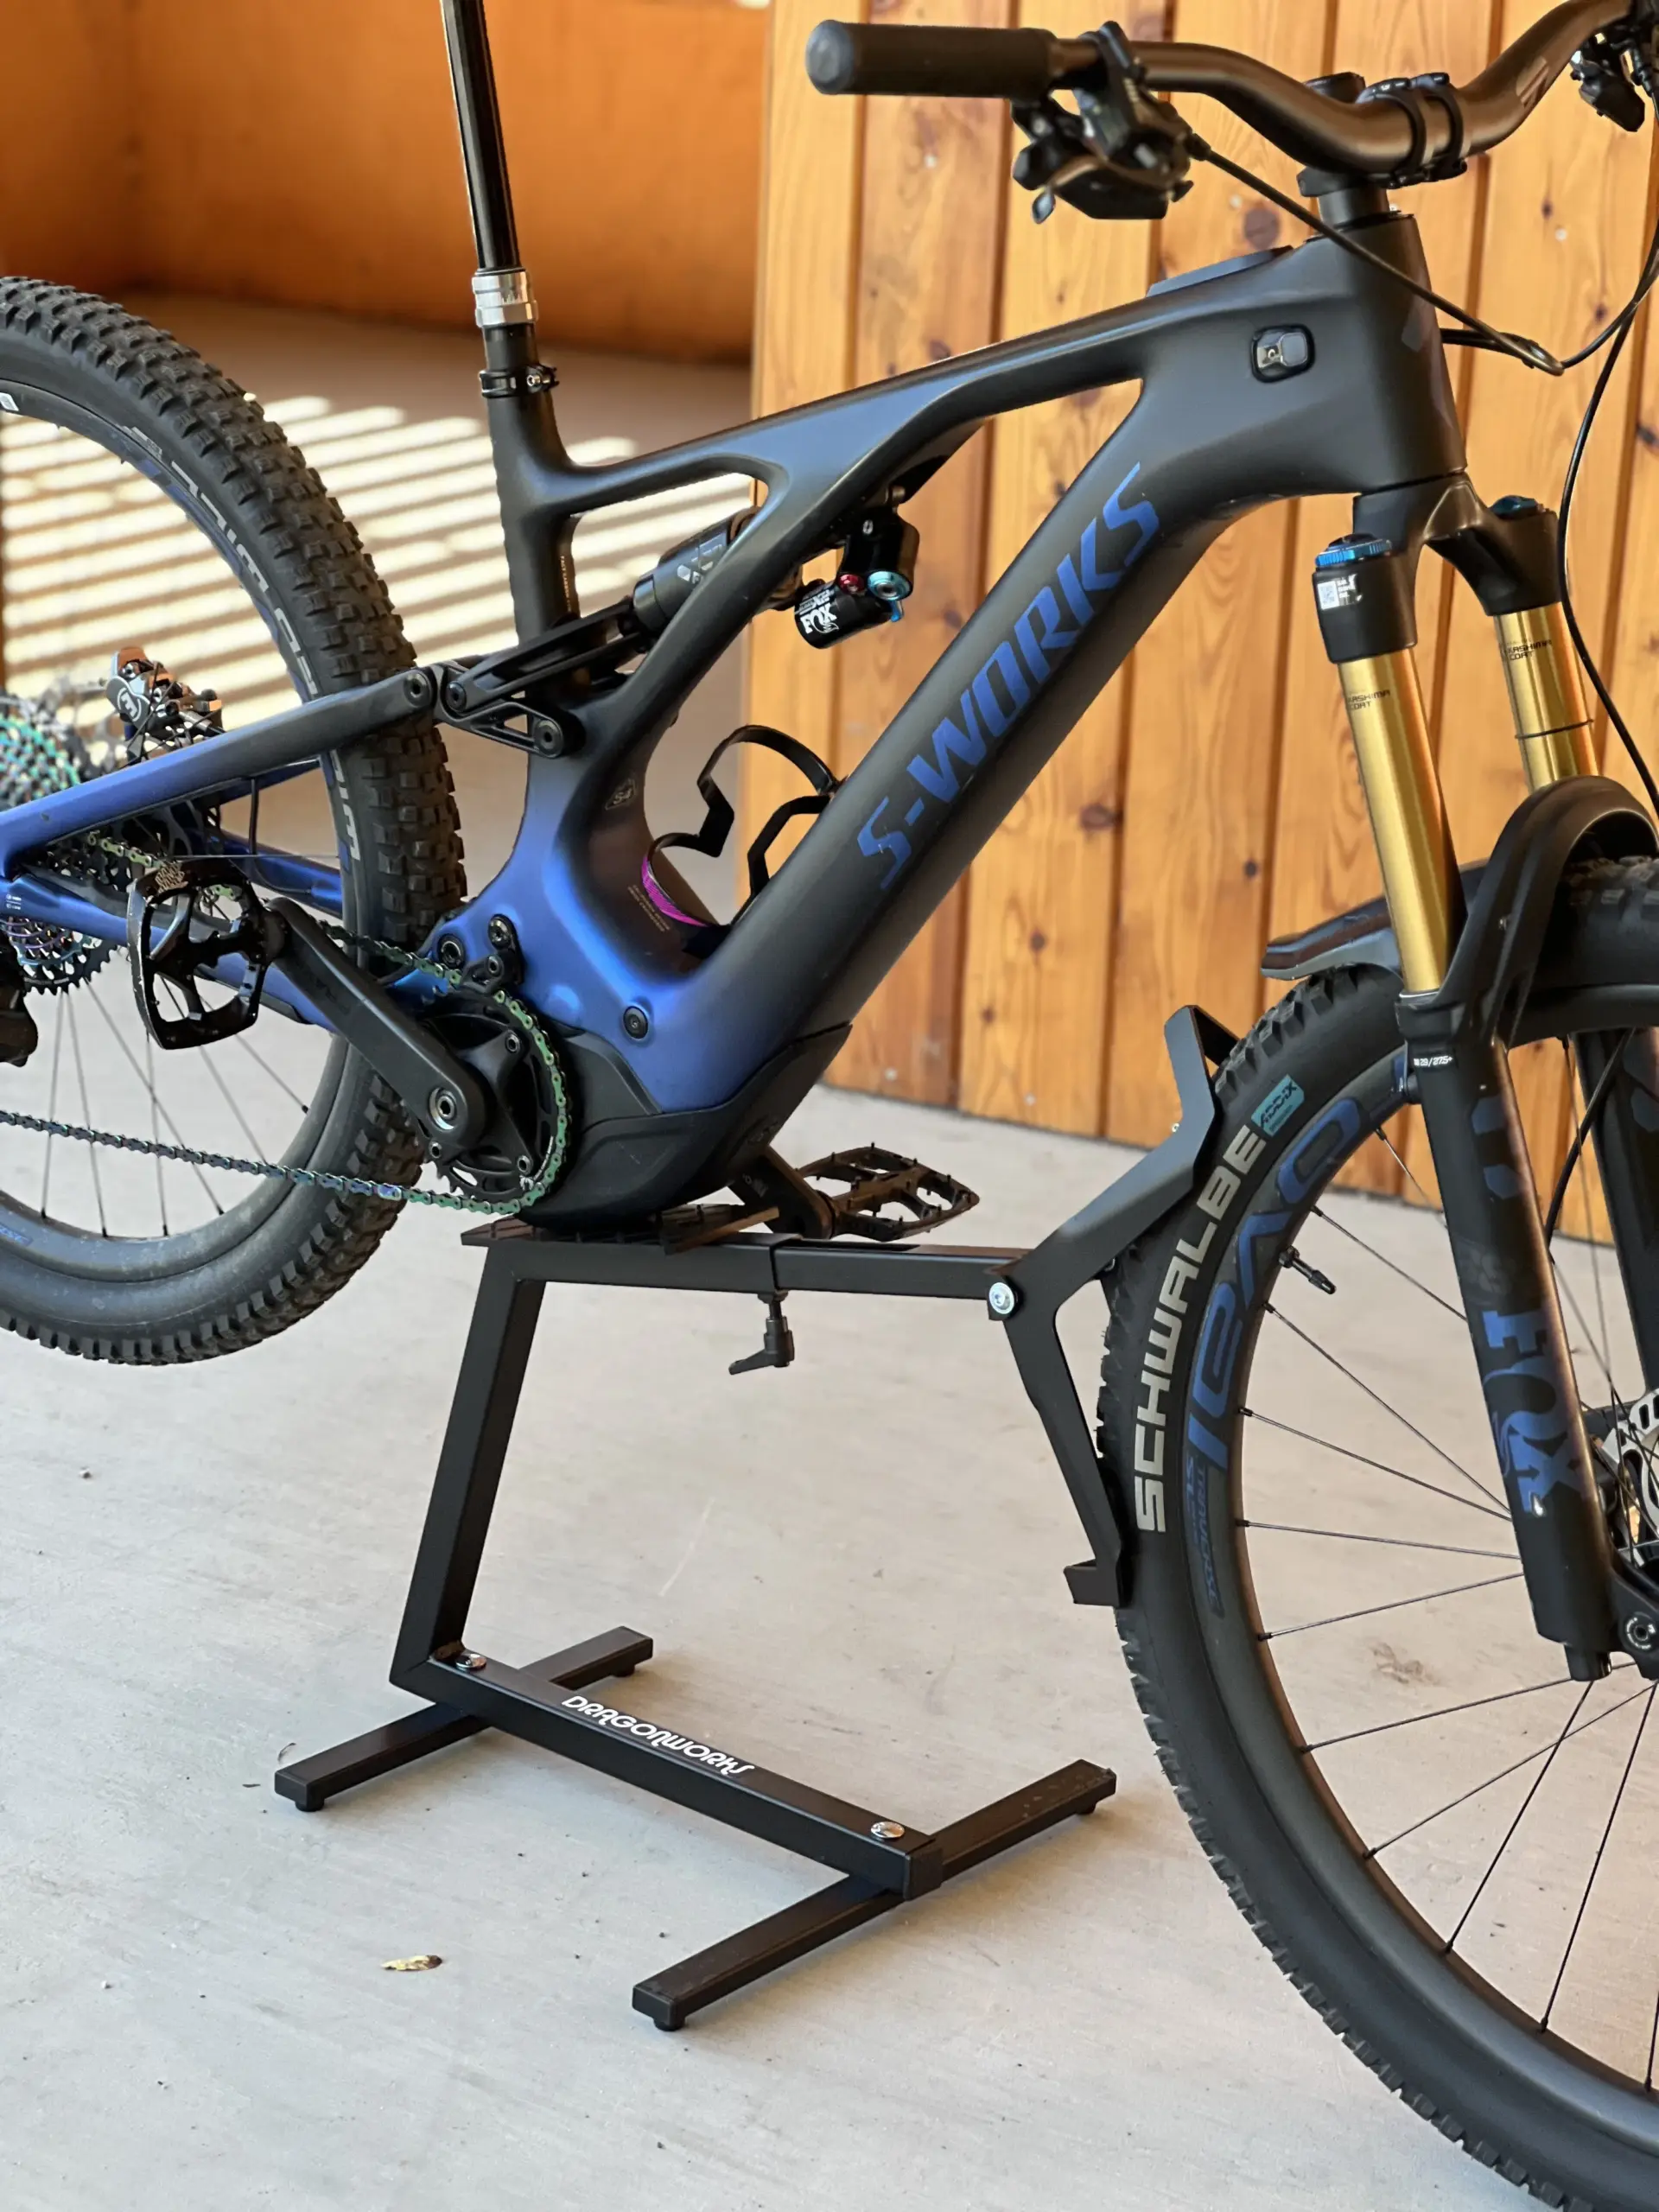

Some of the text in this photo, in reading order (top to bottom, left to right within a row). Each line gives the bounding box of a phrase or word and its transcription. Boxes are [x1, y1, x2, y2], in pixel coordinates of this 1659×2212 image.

[799, 603, 839, 633] FOX
[857, 461, 1160, 890] S-WORKS
[1260, 1082, 1298, 1128] ADDIX
[1134, 1124, 1267, 1533] SCHWALBE
[1188, 1053, 1405, 1470] OVAL
[1483, 1310, 1588, 1513] FOX
[562, 1695, 755, 1776] DRAGONWORKS
